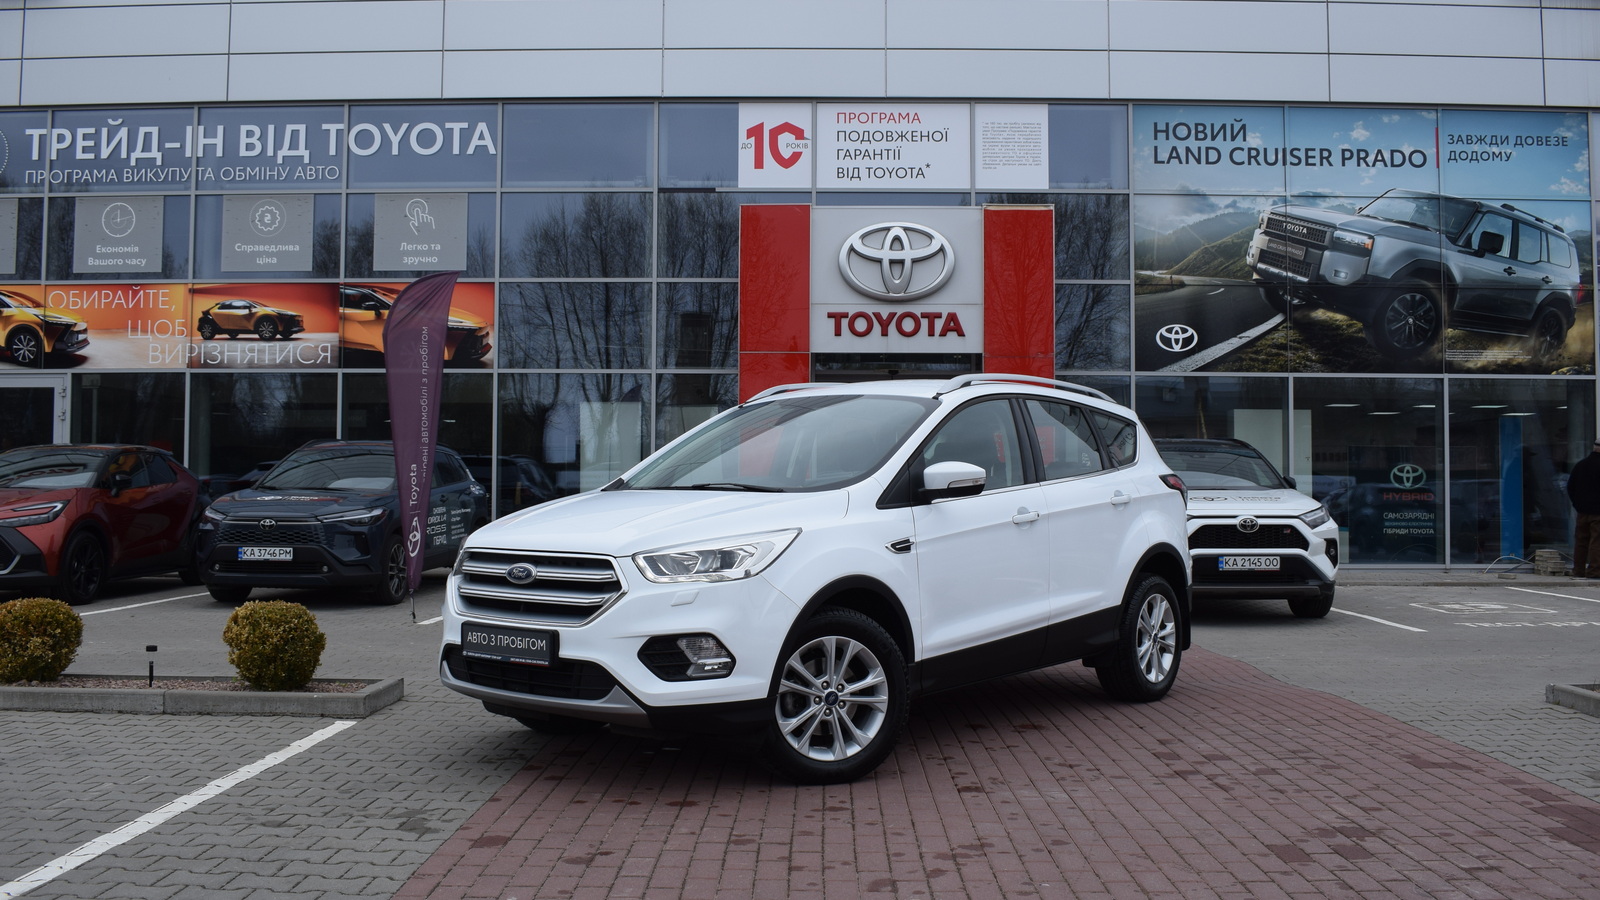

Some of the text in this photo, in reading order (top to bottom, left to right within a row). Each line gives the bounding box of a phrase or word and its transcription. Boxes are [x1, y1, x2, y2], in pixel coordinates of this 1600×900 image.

[836, 112, 921, 124] ПРОГРАМА
[836, 128, 950, 144] ПОДОВЖЕНОЇ
[1153, 118, 1247, 142] НОВИЙ
[25, 118, 497, 166] ТРЕЙД-ІН ВІД TOYOTA
[741, 142, 752, 150] ДО
[1447, 134, 1569, 148] ЗАВЖДИ ДОВЕЗЕ
[836, 146, 902, 160] ГАРАНТІЇ
[1153, 146, 1428, 168] LAND CRUISER PRADO
[1447, 150, 1513, 163] ДОДОМУ
[25, 165, 340, 184] ПРОГРАМА ВИКУПУ ТА ОБМІНУ АВТО
[836, 167, 862, 181] ВІД
[96, 244, 139, 253] Економія
[234, 243, 300, 253] Справедлива
[400, 242, 441, 251] Легко та
[88, 257, 147, 267] Вашого часу
[256, 255, 277, 265] ціна
[403, 256, 438, 265] зручно
[48, 286, 176, 312] ОБИРАЙТЕ,
[128, 319, 188, 339] ЩОБ
[827, 311, 965, 337] TOYOTA
[149, 343, 332, 364] ВИРІЗНЯТИСЯ
[420, 326, 430, 375] пробігом
[420, 386, 429, 444] автомобілі
[409, 463, 420, 507] Toyota
[1383, 492, 1435, 501] HYBRID
[257, 548, 277, 558] 3746
[1240, 558, 1262, 568] 2145
[511, 567, 528, 578] Ford
[467, 631, 489, 645] АВТО
[497, 635, 546, 651] ПРОБІГОМ
